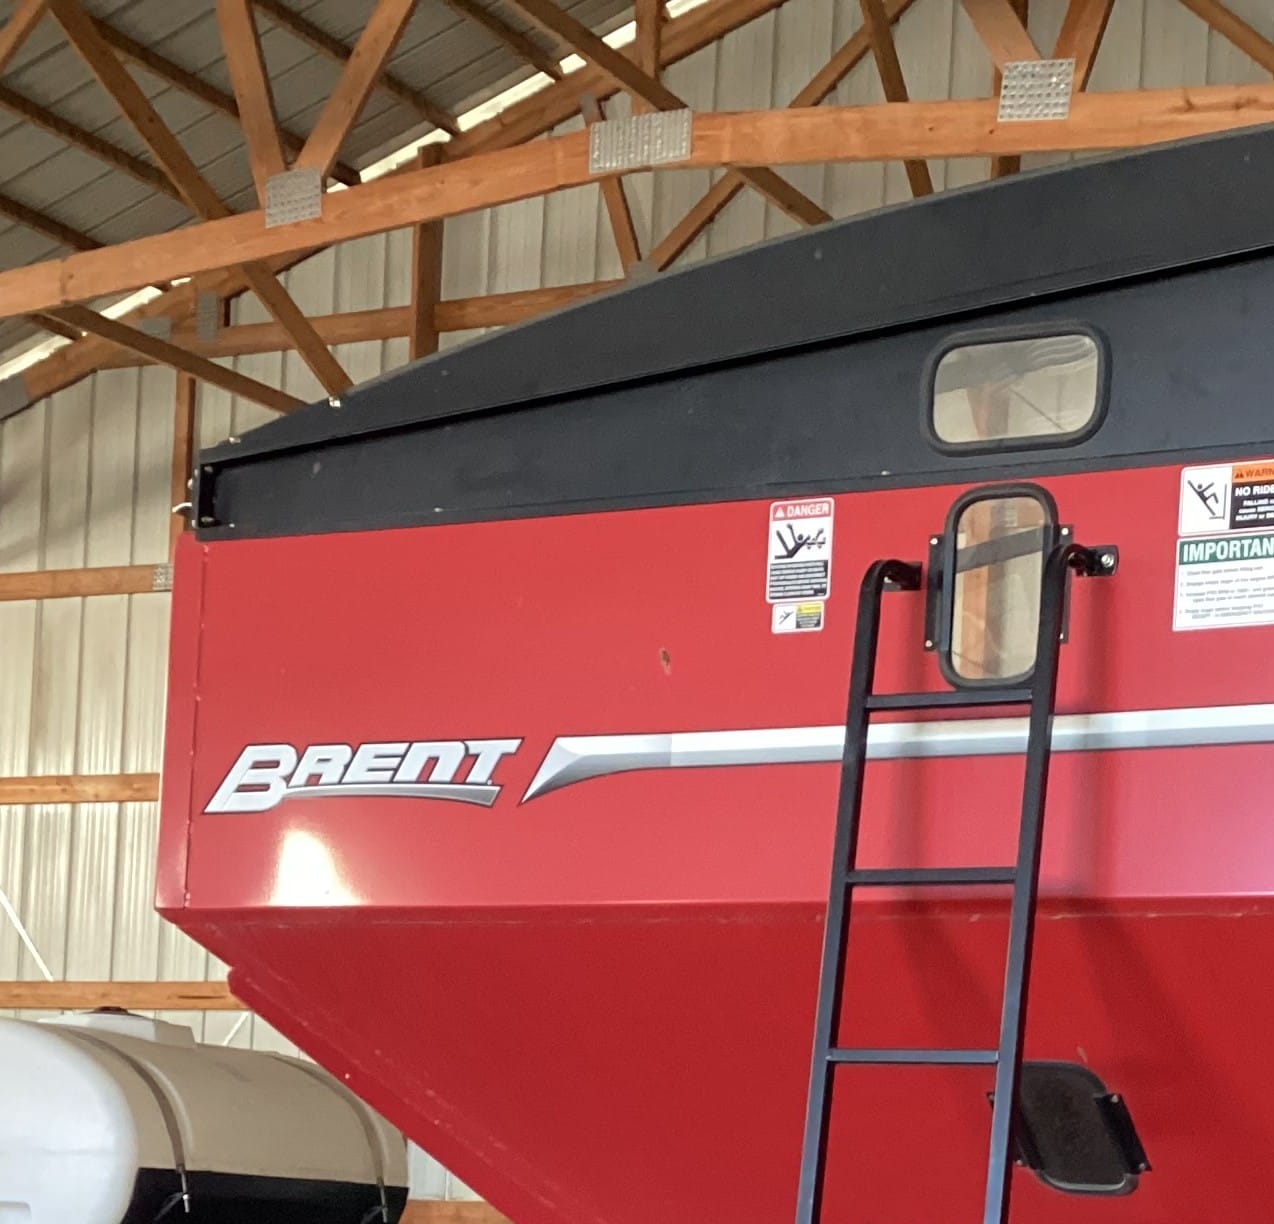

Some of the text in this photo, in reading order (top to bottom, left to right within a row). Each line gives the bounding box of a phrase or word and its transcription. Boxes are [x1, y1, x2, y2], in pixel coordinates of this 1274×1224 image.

[1235, 486, 1251, 497] NO
[787, 502, 829, 517] DANGER
[203, 738, 524, 814] BRENT
